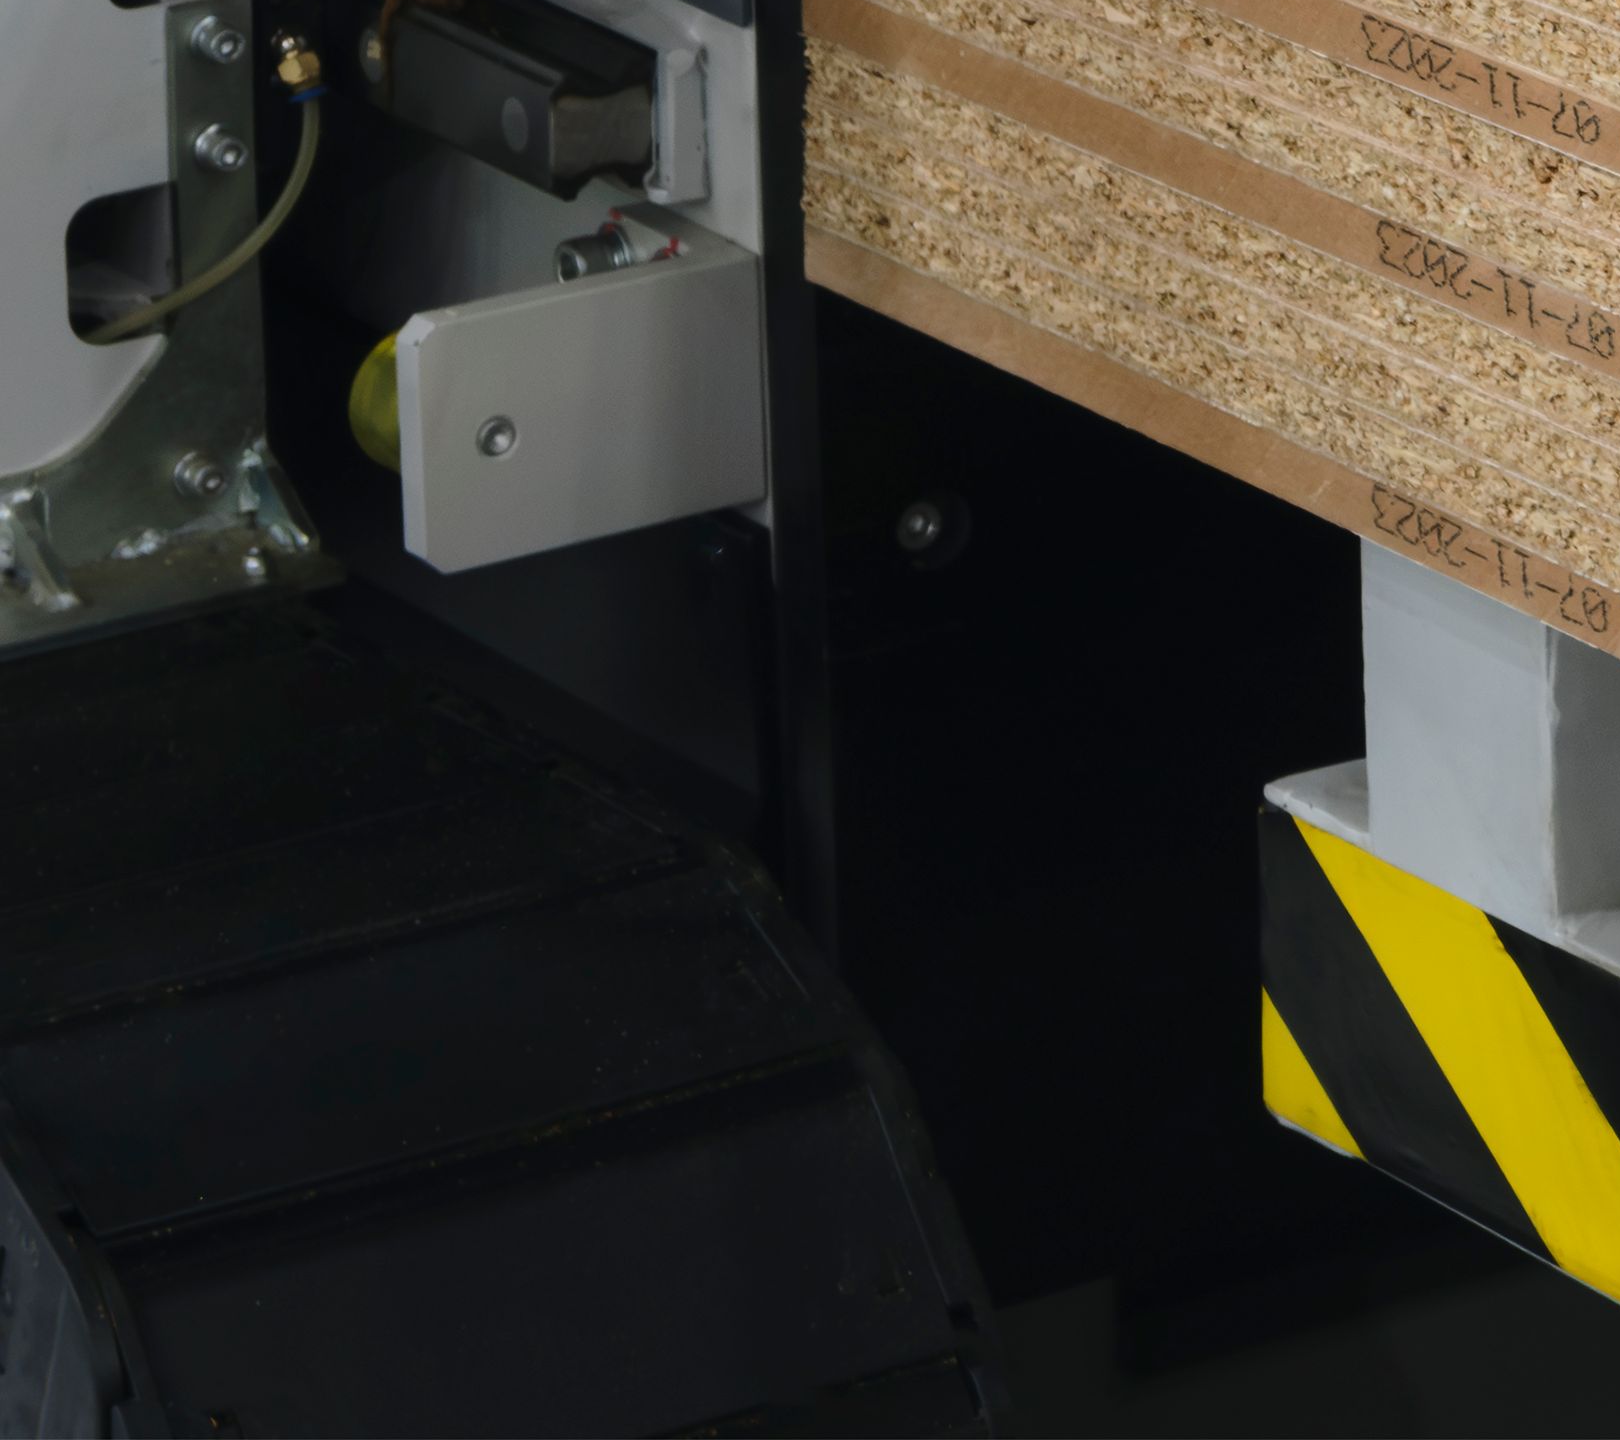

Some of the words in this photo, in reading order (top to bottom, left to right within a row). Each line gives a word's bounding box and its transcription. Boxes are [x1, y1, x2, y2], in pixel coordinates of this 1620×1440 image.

[1360, 13, 1601, 146] 07-11-2023
[1375, 219, 1616, 361] 07-11-2023
[1371, 483, 1609, 634] 07-11-2023
